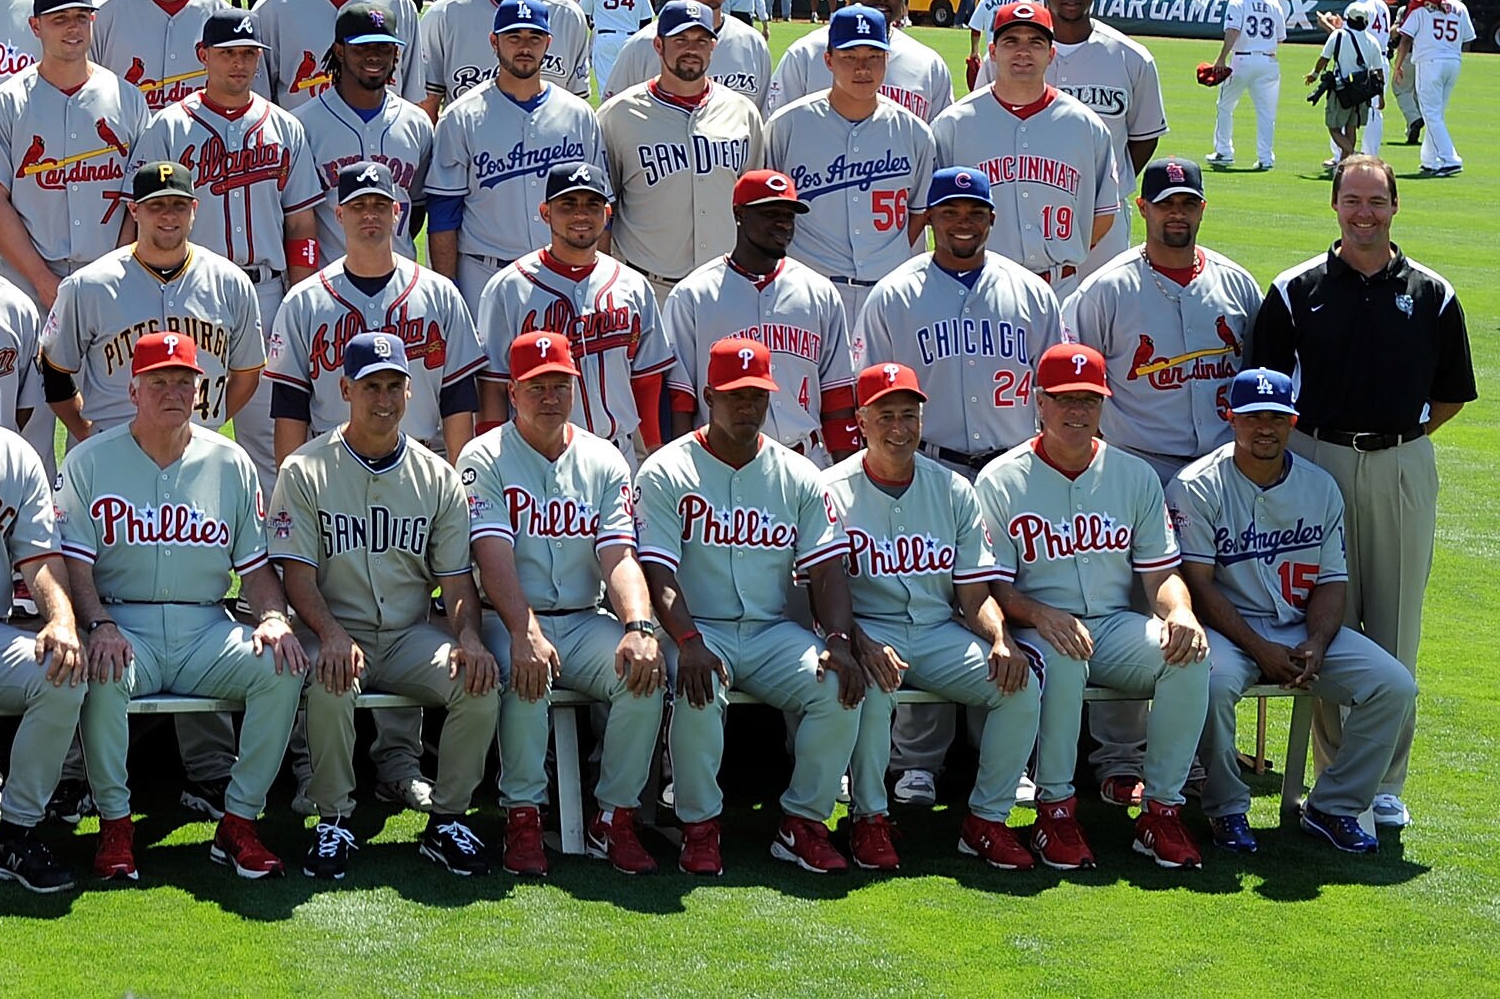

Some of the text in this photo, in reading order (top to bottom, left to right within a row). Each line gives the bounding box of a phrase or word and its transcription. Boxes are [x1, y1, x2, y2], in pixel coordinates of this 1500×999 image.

[517, 0, 531, 20] LA
[1012, 4, 1035, 19] C
[1252, 3, 1268, 13] LEE
[234, 18, 253, 34] A
[855, 14, 870, 35] LA
[1246, 15, 1273, 39] 33
[1372, 12, 1389, 34] 41
[1433, 18, 1458, 42] 55
[473, 136, 585, 180] Los Angeles
[638, 134, 748, 187] SAN DIEGO
[35, 157, 124, 190] Cardinals
[158, 164, 173, 183] P
[355, 165, 380, 183] A
[568, 164, 591, 182] A
[791, 149, 911, 192] Los Angeles
[955, 173, 971, 189] C
[765, 175, 788, 192] C
[101, 191, 128, 224] 7
[871, 190, 909, 232] 56
[1043, 206, 1072, 240] 19
[163, 335, 179, 354] P
[535, 337, 552, 358] P
[917, 320, 1028, 365] CHICAGO
[738, 348, 754, 369] P
[1071, 353, 1087, 375] P
[883, 363, 899, 382] P
[1256, 374, 1273, 394] LA
[195, 376, 227, 421] 47
[798, 377, 810, 414] 4
[993, 370, 1031, 408] 24
[462, 470, 475, 483] 36
[91, 496, 229, 545] Phillies
[504, 487, 600, 537] Phillie
[679, 494, 797, 547] Phillies
[318, 506, 427, 560] SAN DIEG
[1009, 513, 1131, 563] Phillie
[1214, 519, 1323, 562] Los Angeles
[847, 528, 955, 577] Phillie
[1277, 561, 1320, 604] 15
